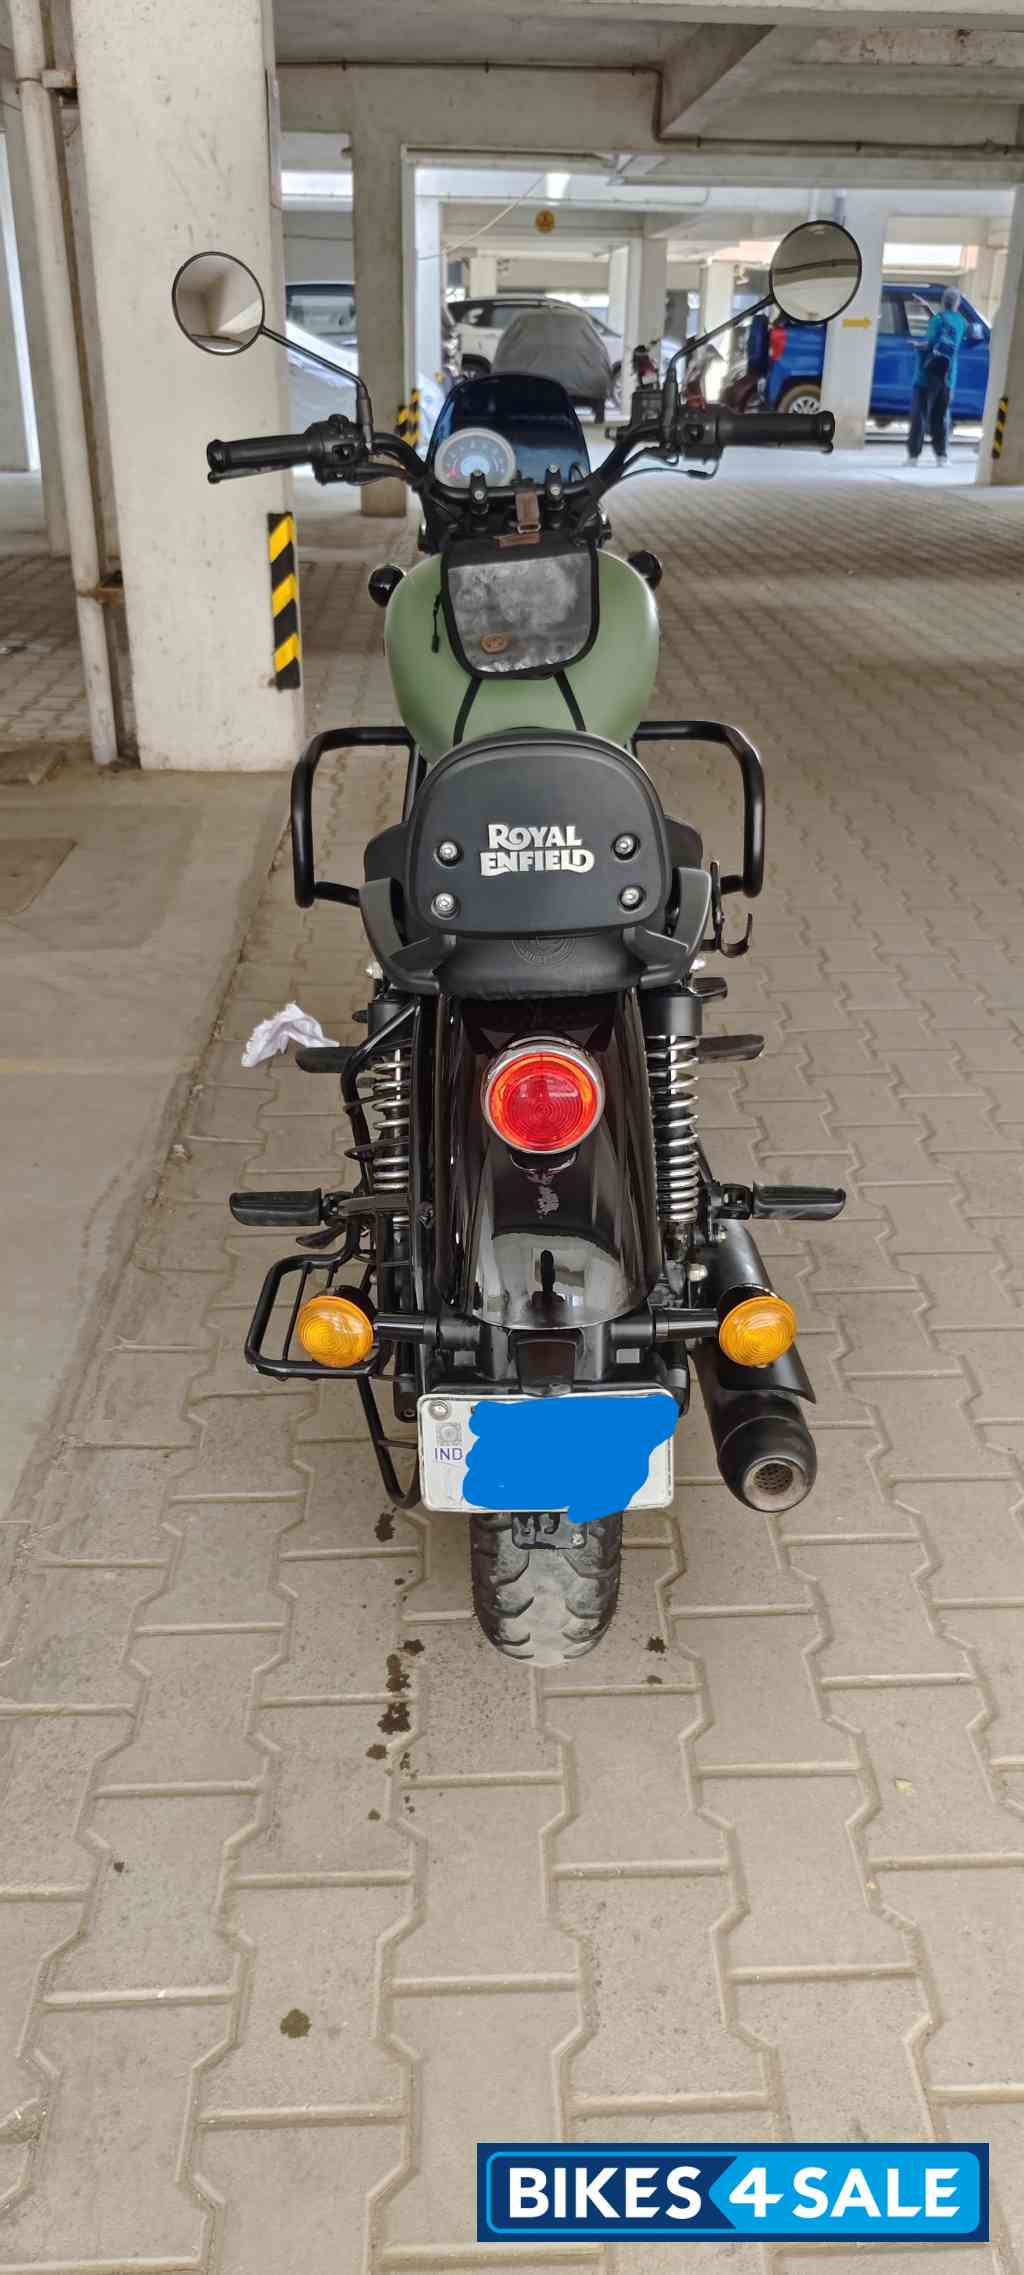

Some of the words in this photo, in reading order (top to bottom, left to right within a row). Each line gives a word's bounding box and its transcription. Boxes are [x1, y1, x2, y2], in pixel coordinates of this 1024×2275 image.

[488, 824, 582, 851] ROYAL
[480, 849, 595, 877] ENFIELD
[434, 1447, 463, 1461] IND
